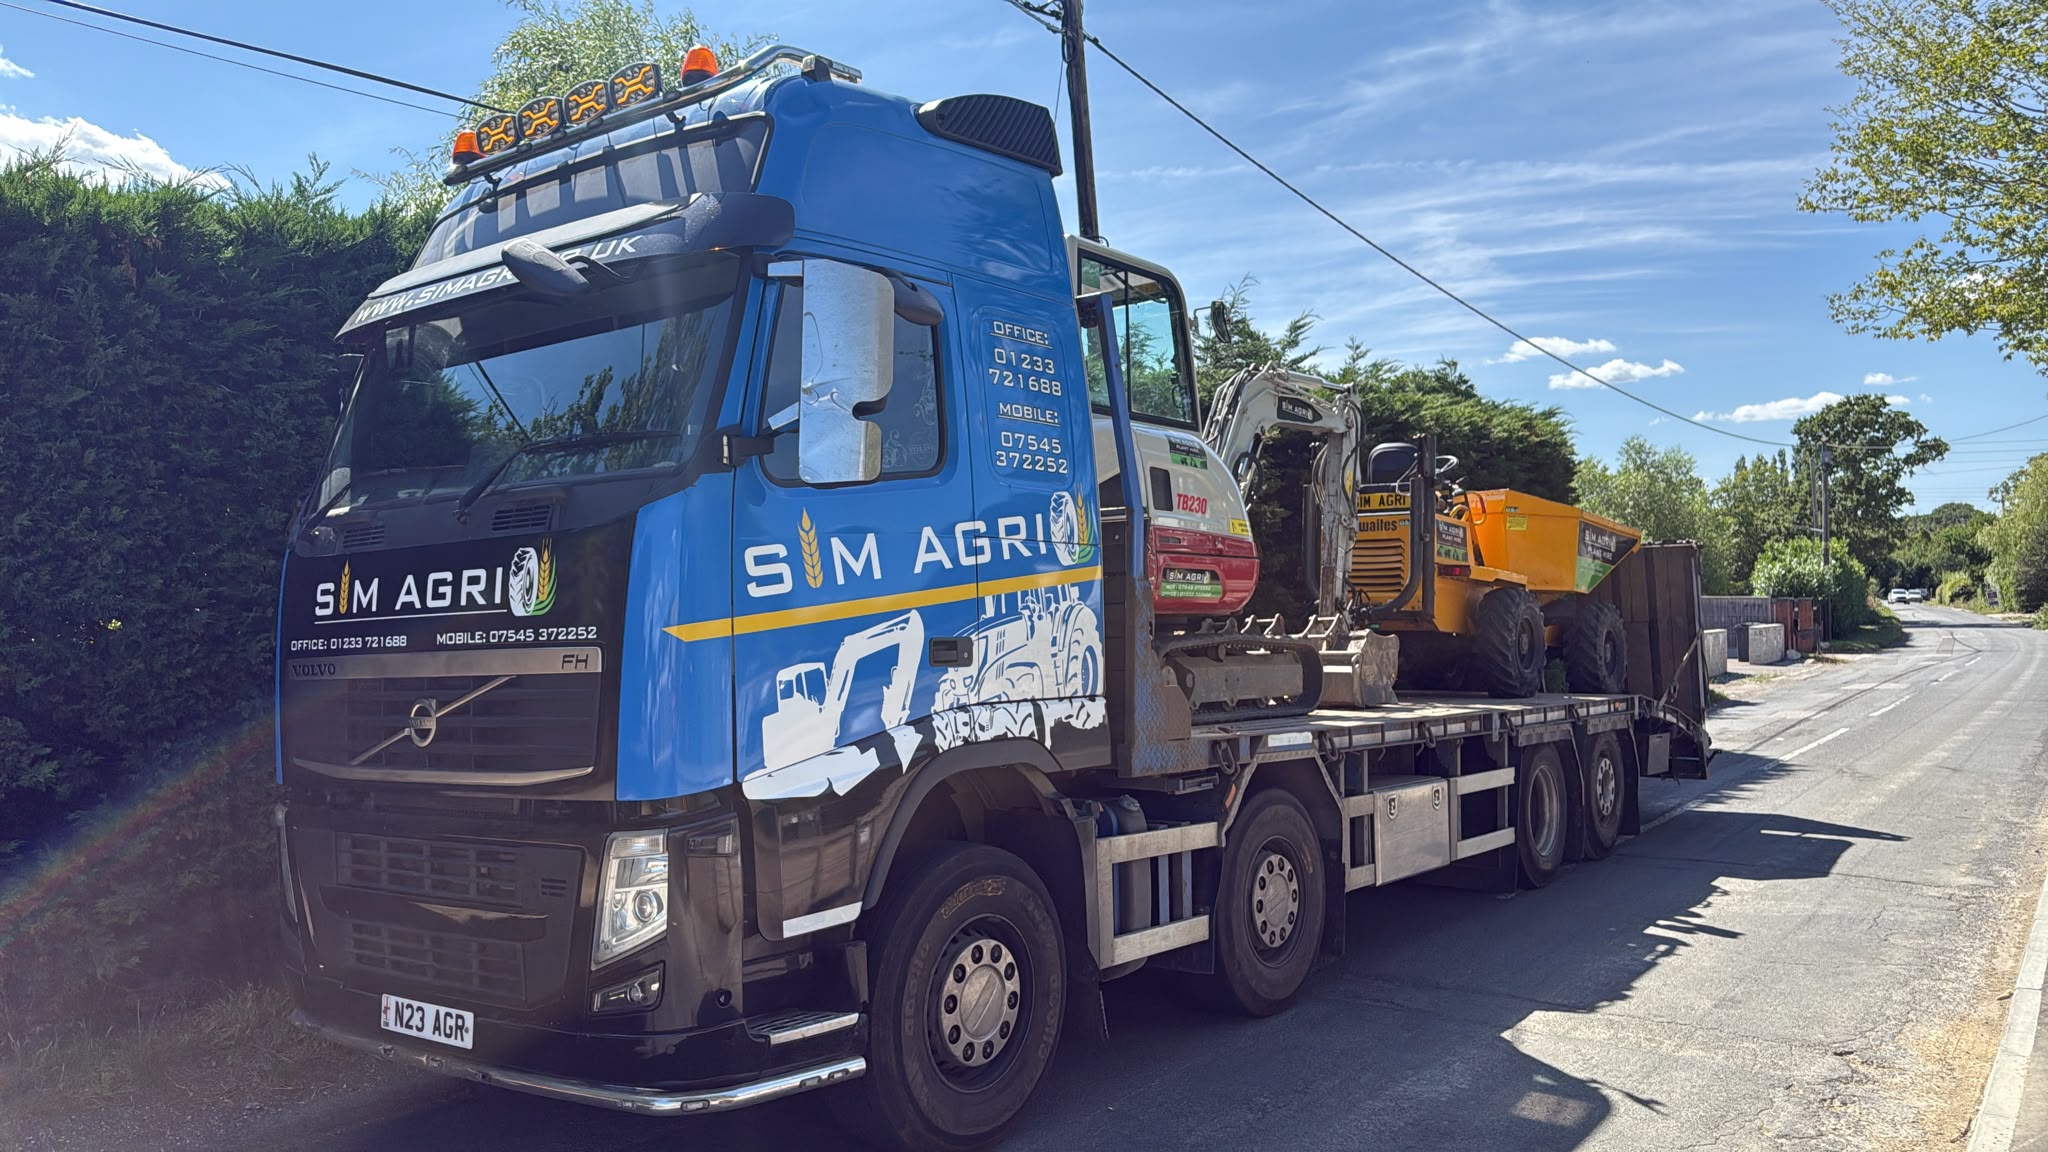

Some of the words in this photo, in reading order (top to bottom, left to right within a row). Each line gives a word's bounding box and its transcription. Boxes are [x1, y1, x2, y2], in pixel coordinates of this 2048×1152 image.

[993, 321, 1049, 345] OFFICE:
[994, 348, 1055, 375] 01233
[988, 368, 1062, 397] 721688
[999, 402, 1059, 424] MOBILE:
[1001, 431, 1062, 454] 07545
[996, 450, 1068, 474] 372252
[1176, 492, 1207, 515] TB230
[1378, 494, 1406, 507] AGRI
[744, 507, 882, 598] SIM
[913, 514, 1047, 574] AGRI
[314, 560, 379, 616] SIM
[395, 567, 503, 611] AGRI
[290, 639, 328, 651] OFFICE:
[330, 637, 363, 650] 01233
[365, 635, 408, 648] 721688
[436, 631, 487, 646] MOBILE:
[489, 629, 535, 643] 07545
[538, 626, 598, 641] 372252
[292, 663, 336, 677] VOLVO
[561, 653, 589, 670] FH
[394, 1001, 425, 1034] N23
[432, 1008, 466, 1043] AGR
